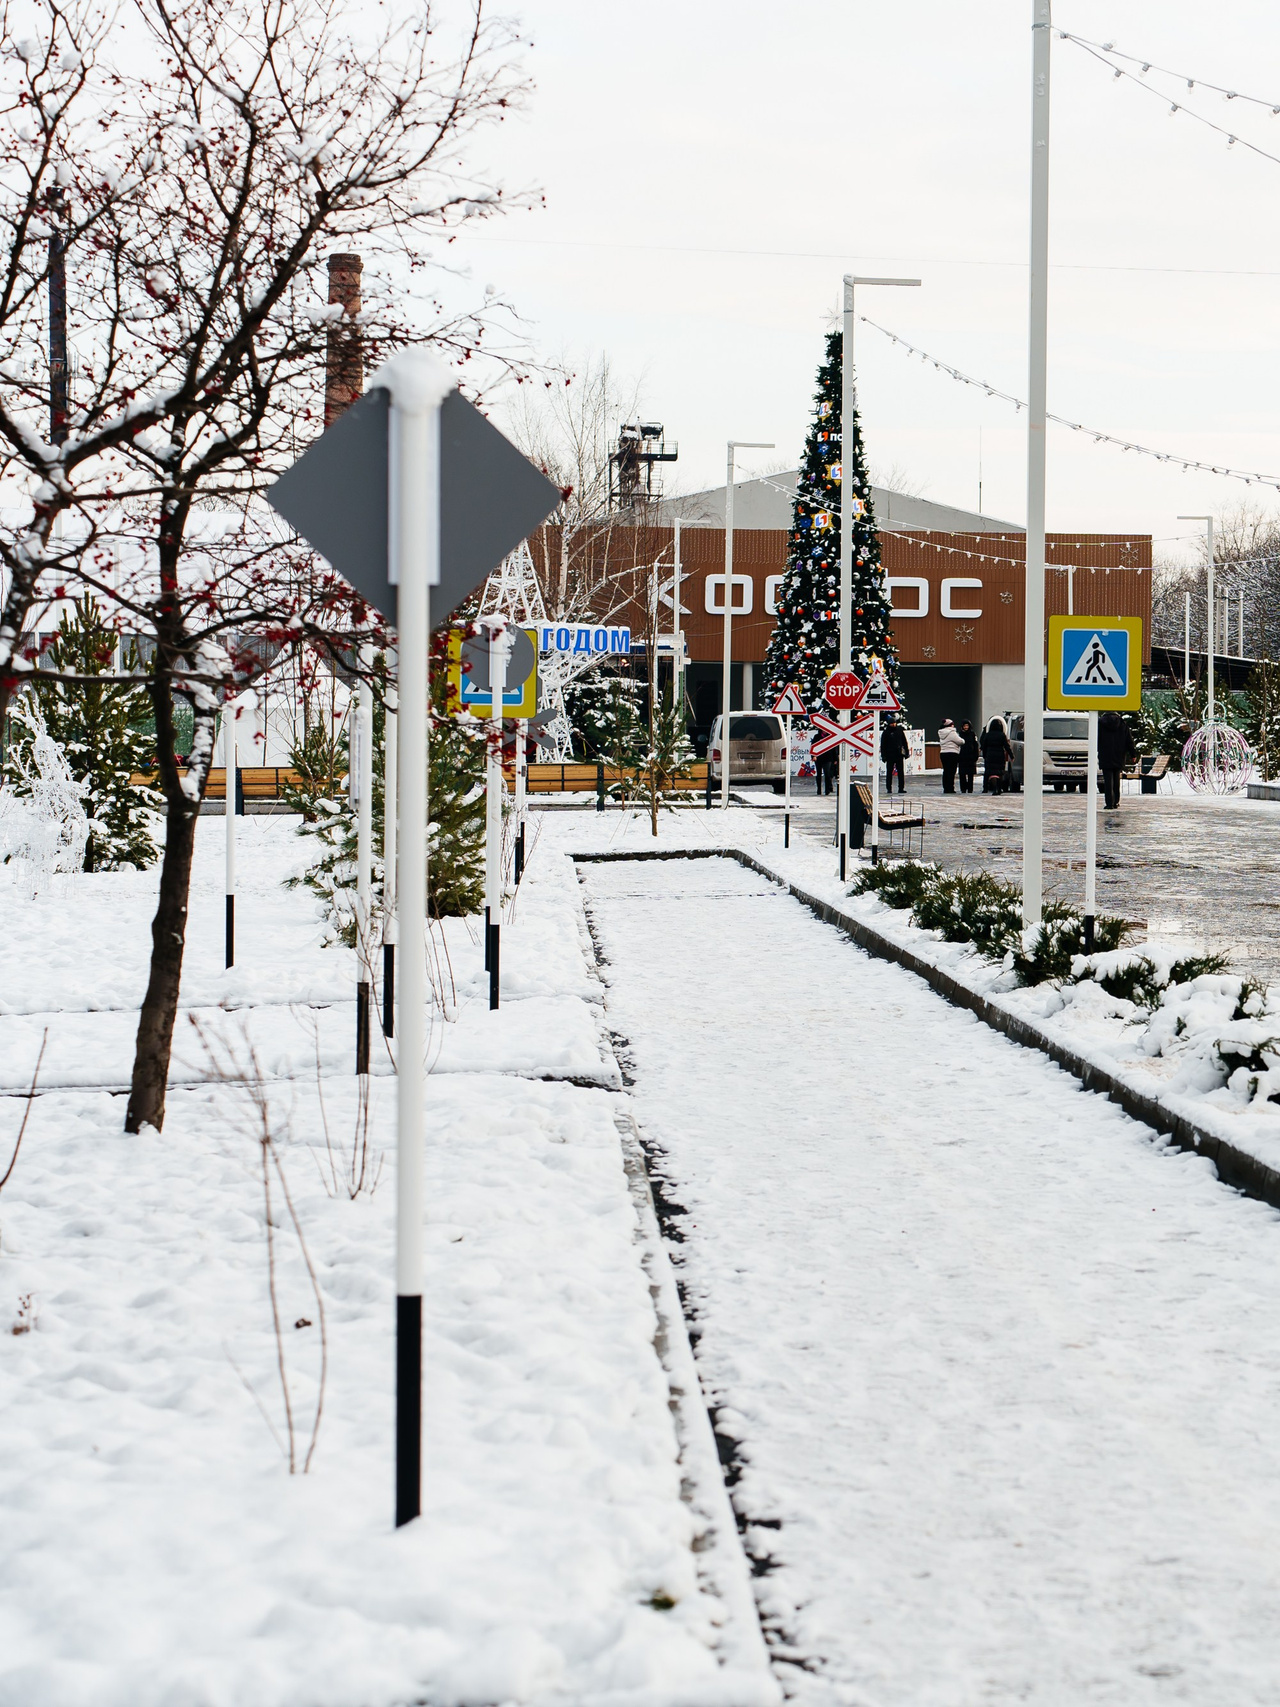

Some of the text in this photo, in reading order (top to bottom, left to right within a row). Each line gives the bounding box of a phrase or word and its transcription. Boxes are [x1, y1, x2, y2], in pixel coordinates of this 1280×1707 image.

[648, 573, 983, 619] КООС
[542, 627, 630, 655] ГОДОМ
[828, 685, 860, 697] STOP
